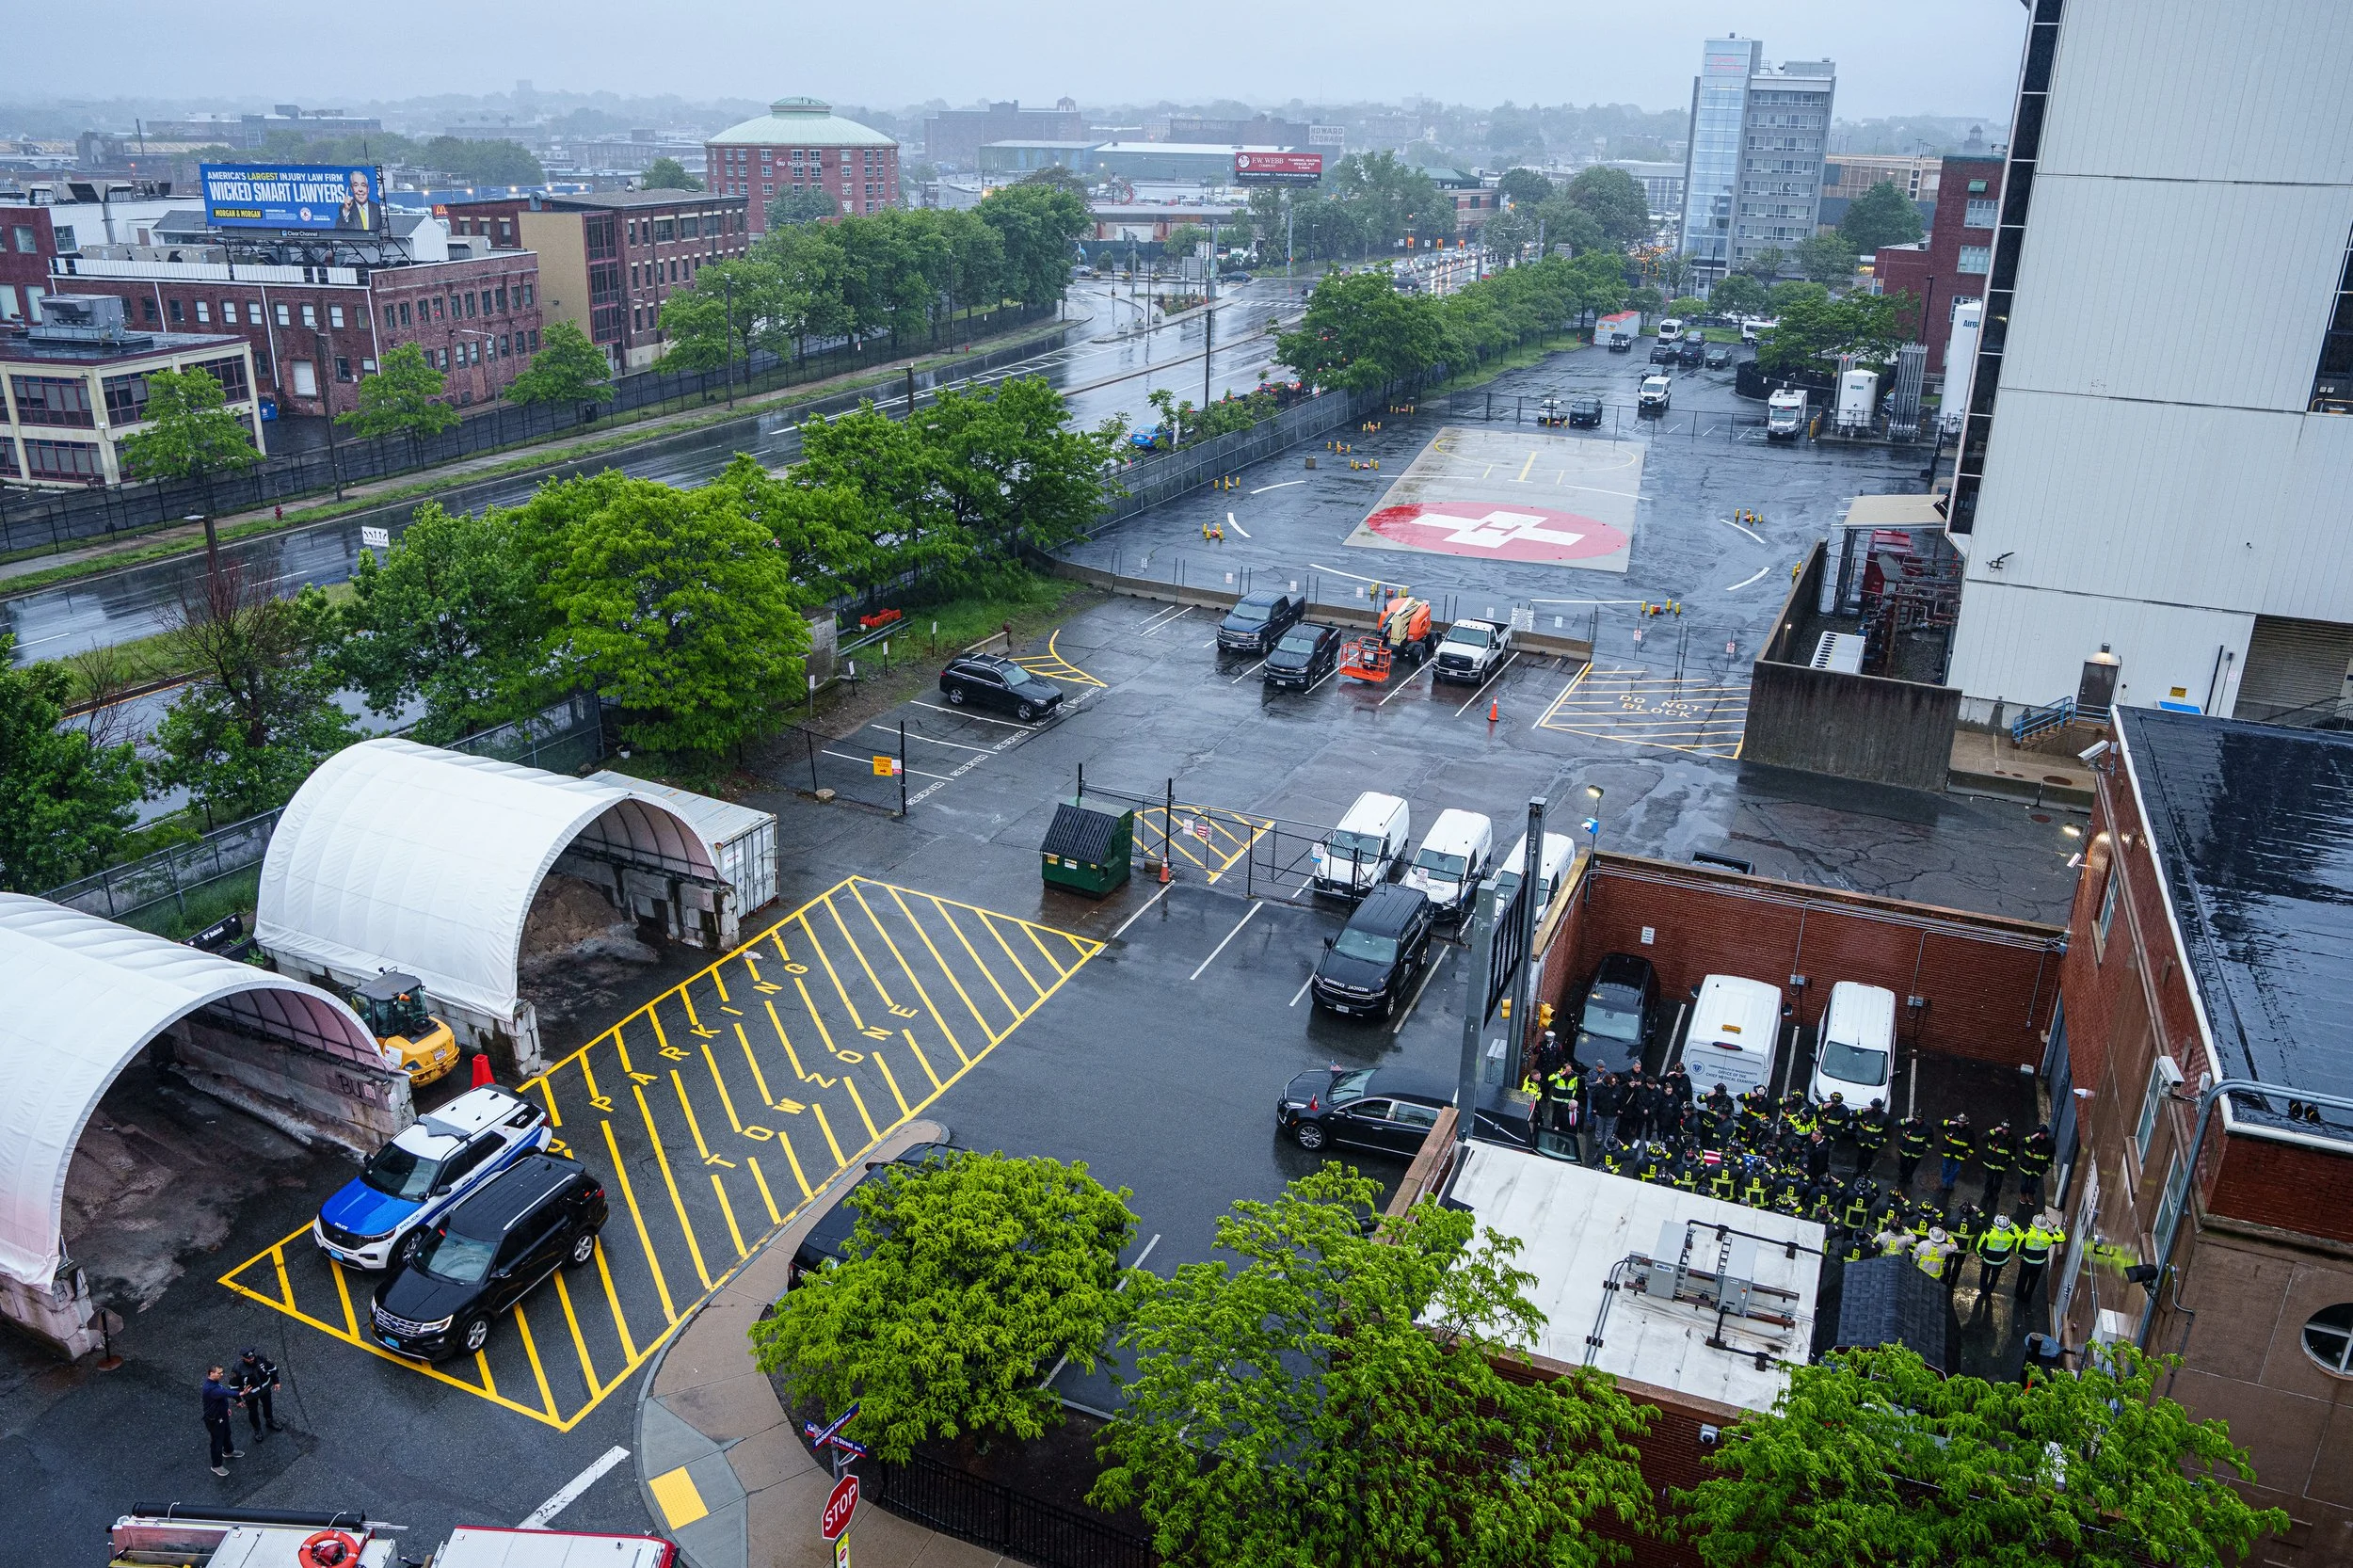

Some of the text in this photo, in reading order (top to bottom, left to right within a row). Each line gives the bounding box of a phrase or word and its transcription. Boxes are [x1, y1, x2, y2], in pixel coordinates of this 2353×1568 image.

[207, 171, 247, 180] AMERICA'S
[247, 172, 278, 181] LARGEST
[308, 173, 324, 182] LAW
[325, 173, 344, 182] FIRM
[209, 182, 344, 203] WICKED SMART LAWYERS
[215, 209, 235, 217] MORGAN
[241, 210, 262, 218] MORGAN
[1963, 320, 1980, 328] Airga
[1471, 521, 1522, 536] H
[1069, 687, 1100, 705] RESERVED
[1619, 695, 1703, 712] DO NOT
[1622, 703, 1692, 718] BLOCK
[992, 730, 1029, 751] RESERVED
[950, 754, 988, 776] RESERVED
[906, 781, 945, 806] RESERVED
[705, 1004, 919, 1168] TOW ZONE
[334, 1222, 348, 1230] POLICE
[399, 1213, 420, 1230] POLICE
[815, 1426, 834, 1446] BioSquare
[834, 1418, 845, 1429] Drive
[838, 1437, 854, 1448] Street
[825, 1483, 856, 1531] STOP
